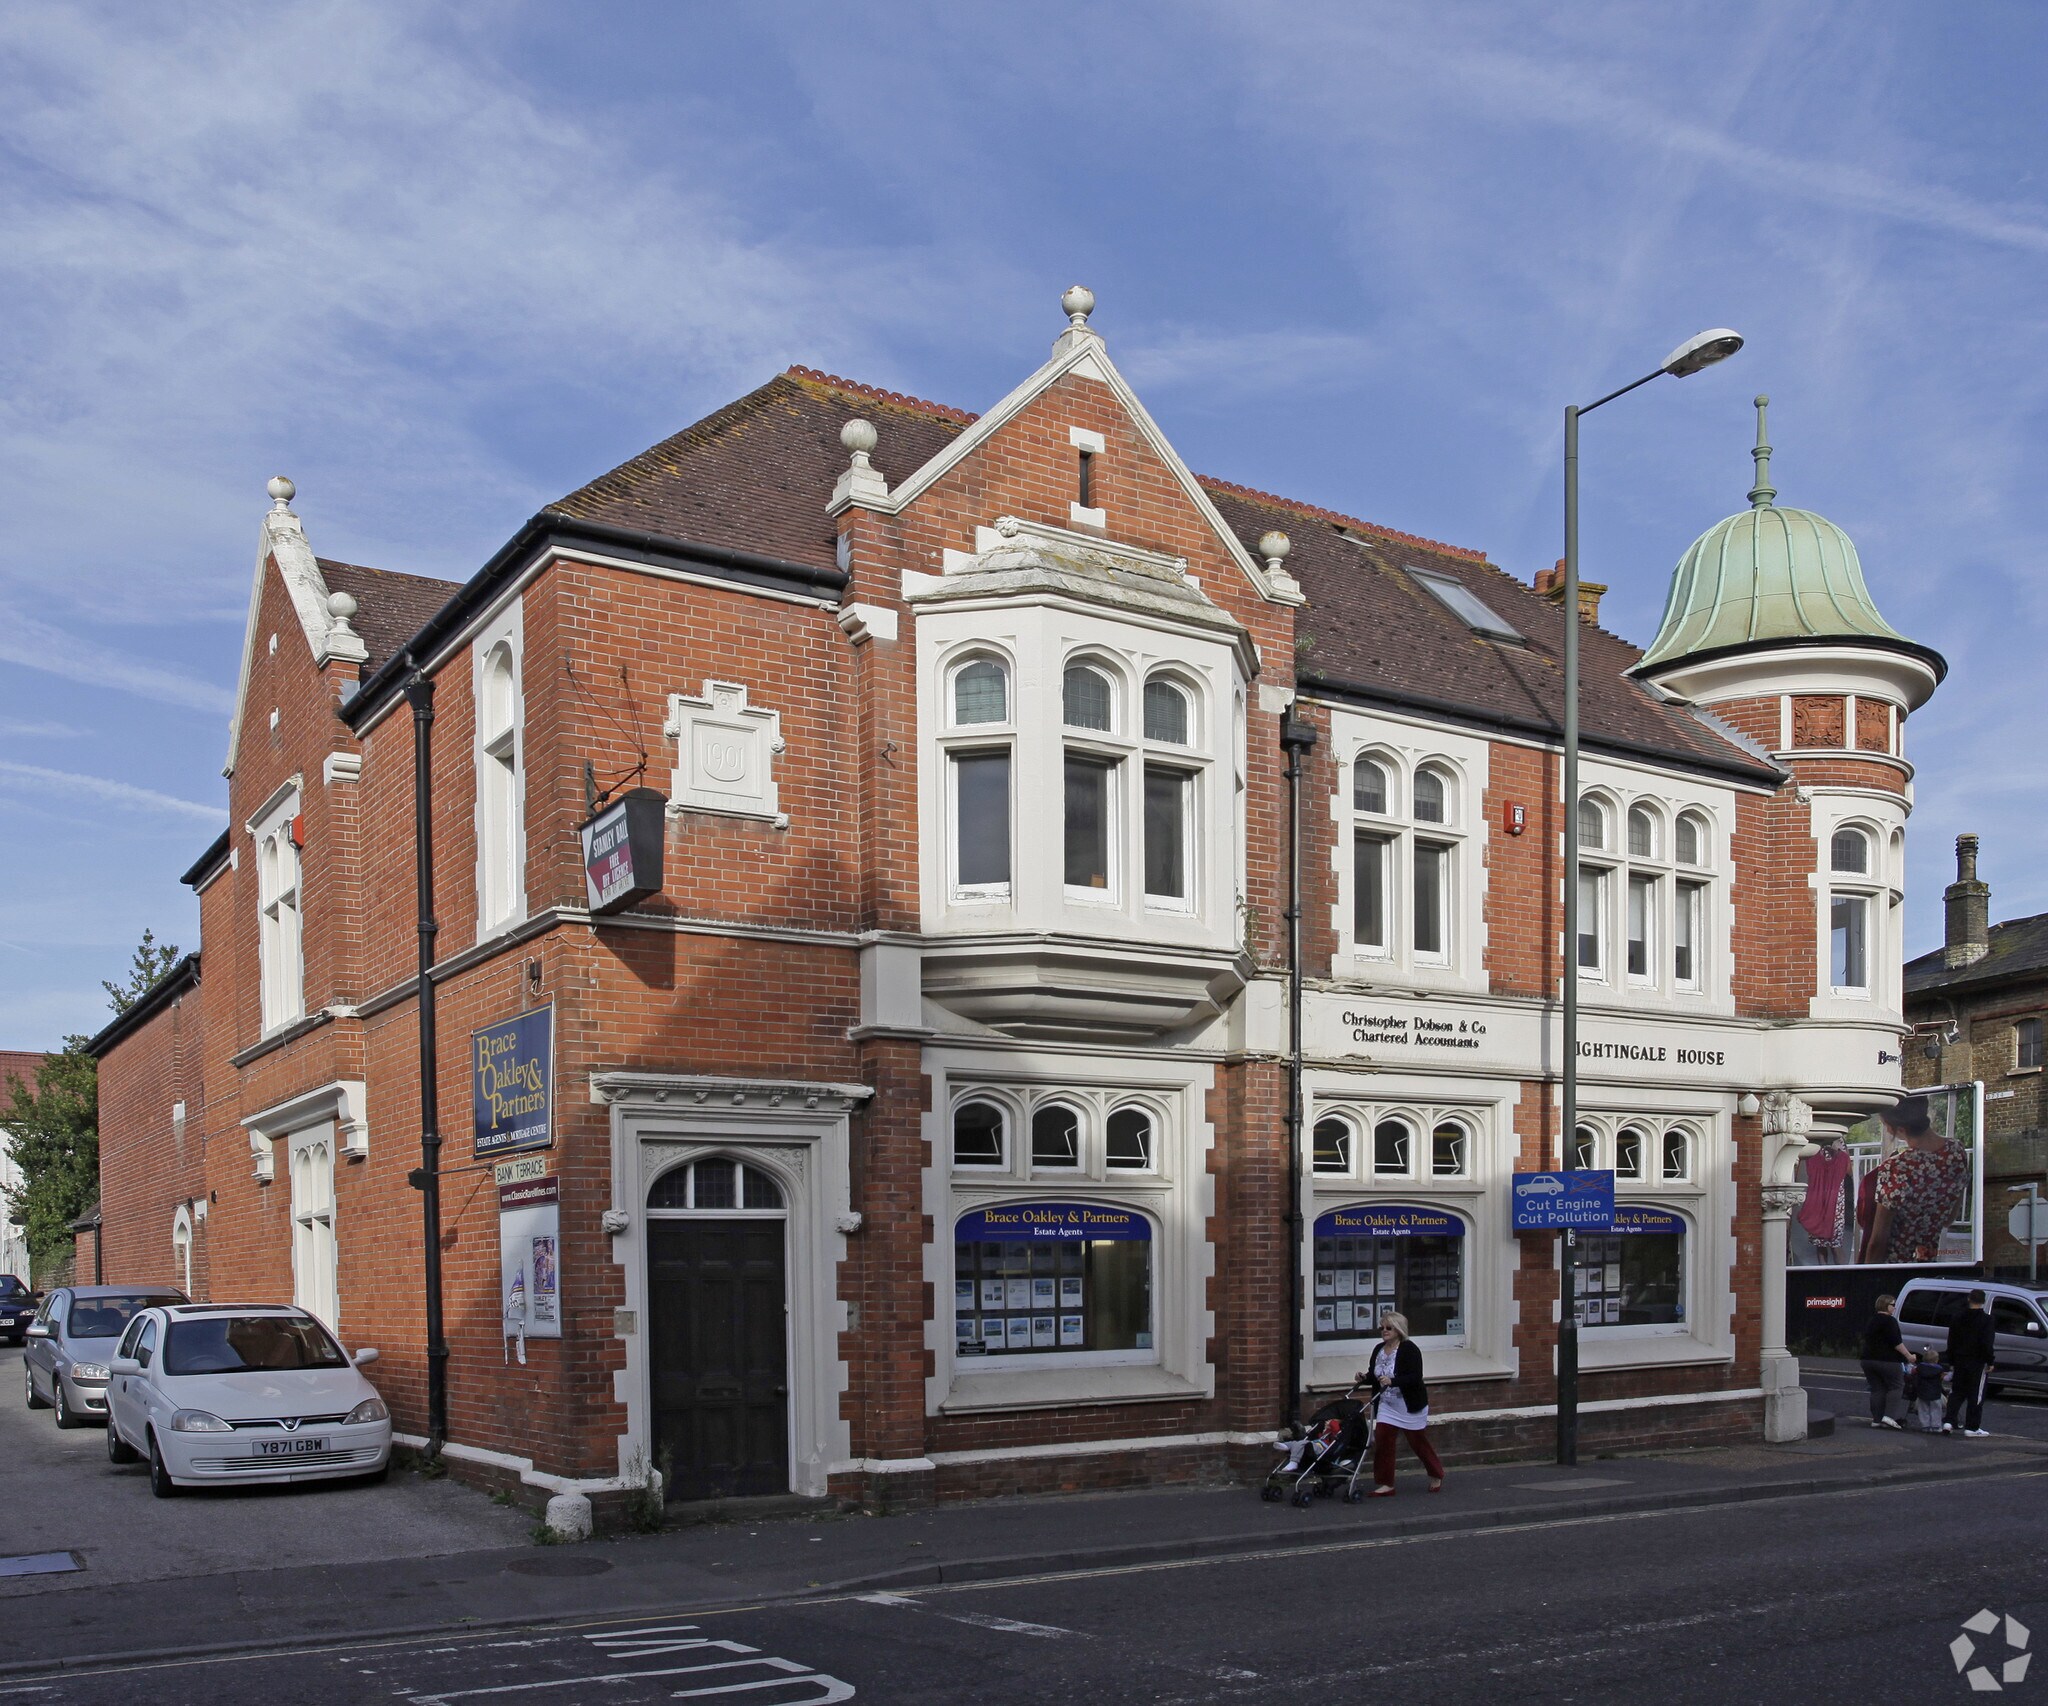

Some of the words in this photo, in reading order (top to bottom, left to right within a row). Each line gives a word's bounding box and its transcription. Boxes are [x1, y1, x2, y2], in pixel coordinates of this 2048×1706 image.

[706, 742, 744, 771] 1901
[1342, 1011, 1408, 1030] Christopher
[1414, 1017, 1453, 1031] Dobson
[1459, 1020, 1468, 1032] &
[1353, 1029, 1408, 1044] Chartered
[1414, 1033, 1480, 1048] Accountants
[477, 1032, 517, 1072] Brace
[1576, 1041, 1667, 1061] IGHTINGALE
[1677, 1049, 1725, 1065] HOUSE
[481, 1058, 528, 1100] Oakley
[491, 1090, 545, 1129] Partners
[477, 1136, 491, 1148] ESTATE
[491, 1133, 506, 1145] AGENTS
[511, 1127, 530, 1140] MORTGAGE
[531, 1124, 547, 1136] CENTRE
[497, 1165, 513, 1182] BANK
[516, 1159, 544, 1179] TERRACE
[1526, 1200, 1550, 1211] Cut
[1556, 1198, 1601, 1211] Engine
[985, 1210, 1019, 1223] Brace
[1022, 1210, 1064, 1225] Oakley
[1068, 1210, 1079, 1223] &
[1082, 1210, 1130, 1223] Partners
[1334, 1214, 1362, 1226] Brace
[1364, 1214, 1397, 1227] Oakley
[1399, 1214, 1409, 1225] &
[1411, 1214, 1448, 1225] Partners
[1518, 1213, 1543, 1224] Cut
[1548, 1211, 1609, 1223] Pollution
[1614, 1213, 1631, 1225] kley
[1632, 1213, 1640, 1224] &
[1642, 1213, 1672, 1224] Partners
[1033, 1227, 1056, 1236] Estate
[1057, 1227, 1083, 1237] Agents
[1372, 1228, 1390, 1236] Estate
[1391, 1228, 1411, 1237] Agents
[1806, 1297, 1843, 1307] primesight
[261, 1441, 292, 1453] Y871
[296, 1439, 322, 1452] GBW
